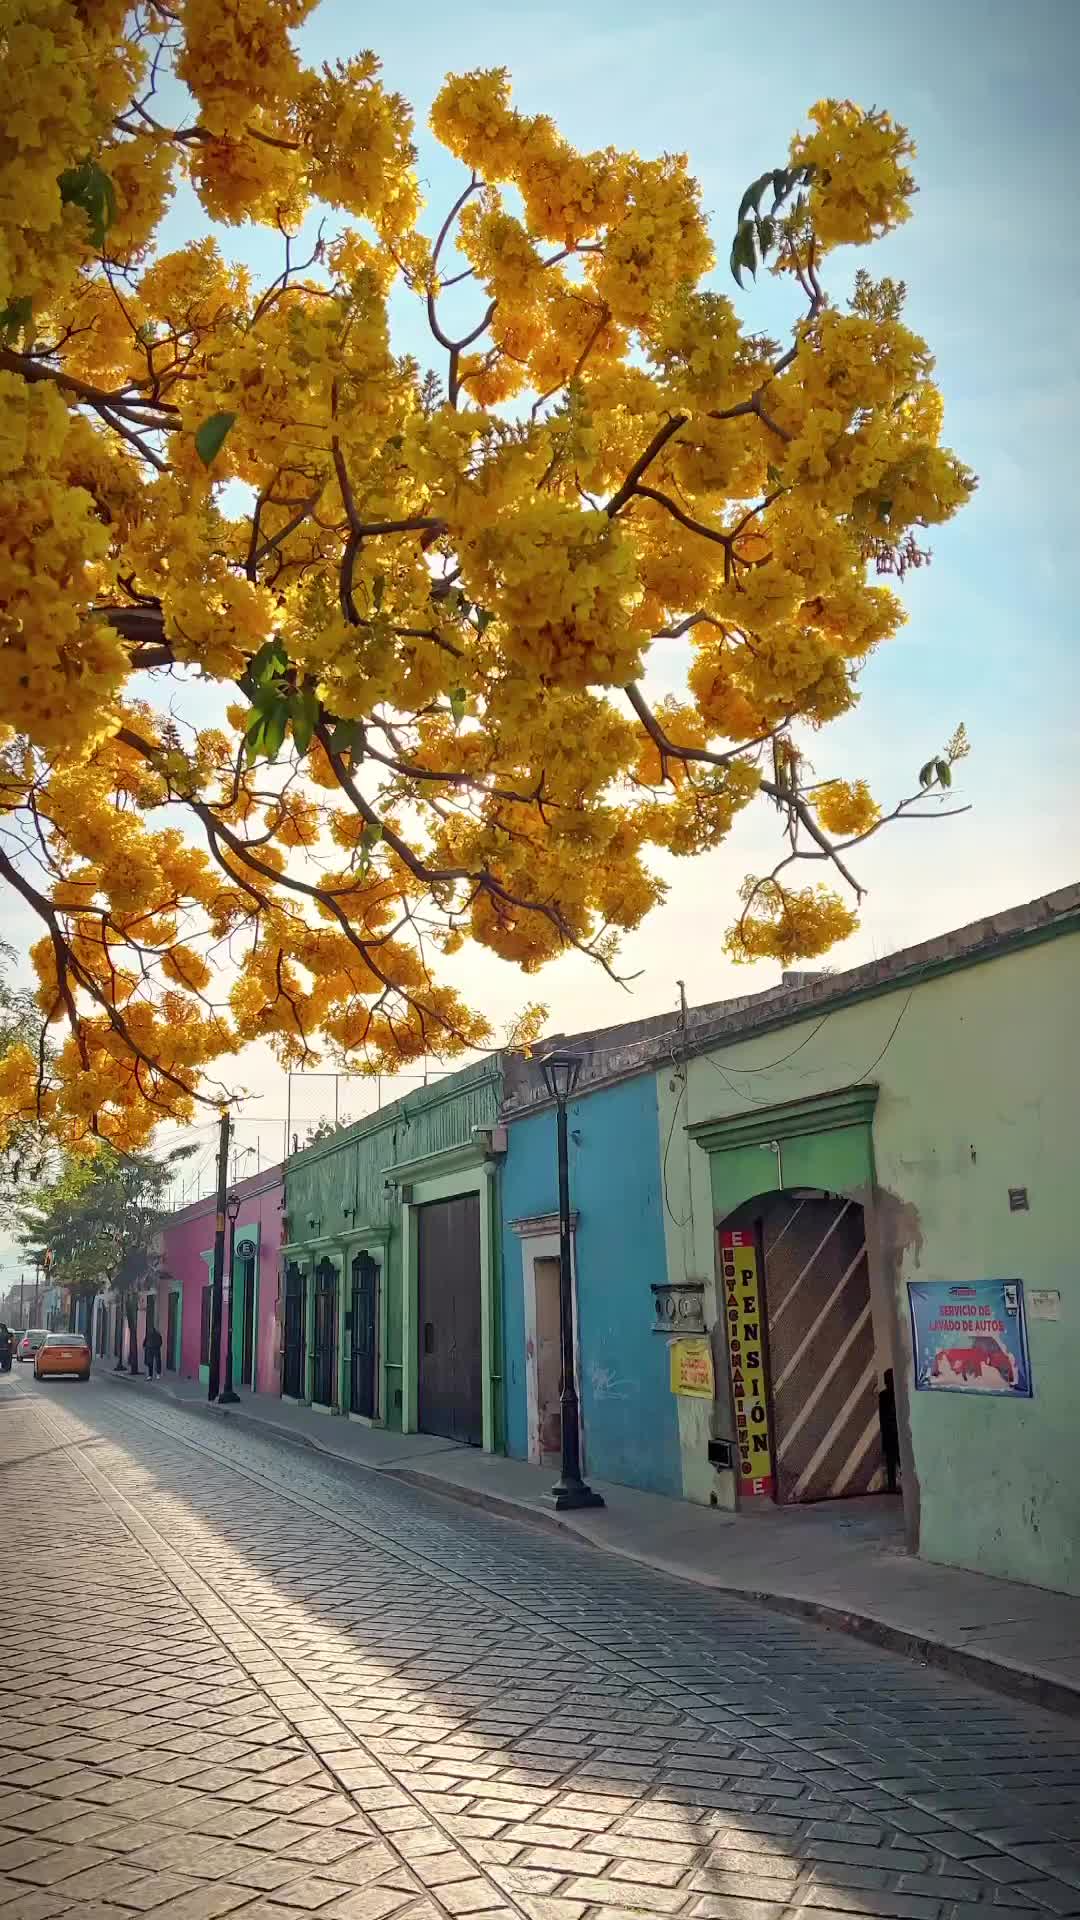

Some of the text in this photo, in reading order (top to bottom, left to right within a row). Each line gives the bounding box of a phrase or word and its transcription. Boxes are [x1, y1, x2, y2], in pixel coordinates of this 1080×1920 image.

[732, 1231, 743, 1247] E
[939, 1305, 992, 1317] SERVICIO DE
[928, 1320, 1006, 1332] LAVADO DE AUTOS
[741, 1268, 769, 1453] PENSIÓN
[753, 1478, 765, 1495] E
